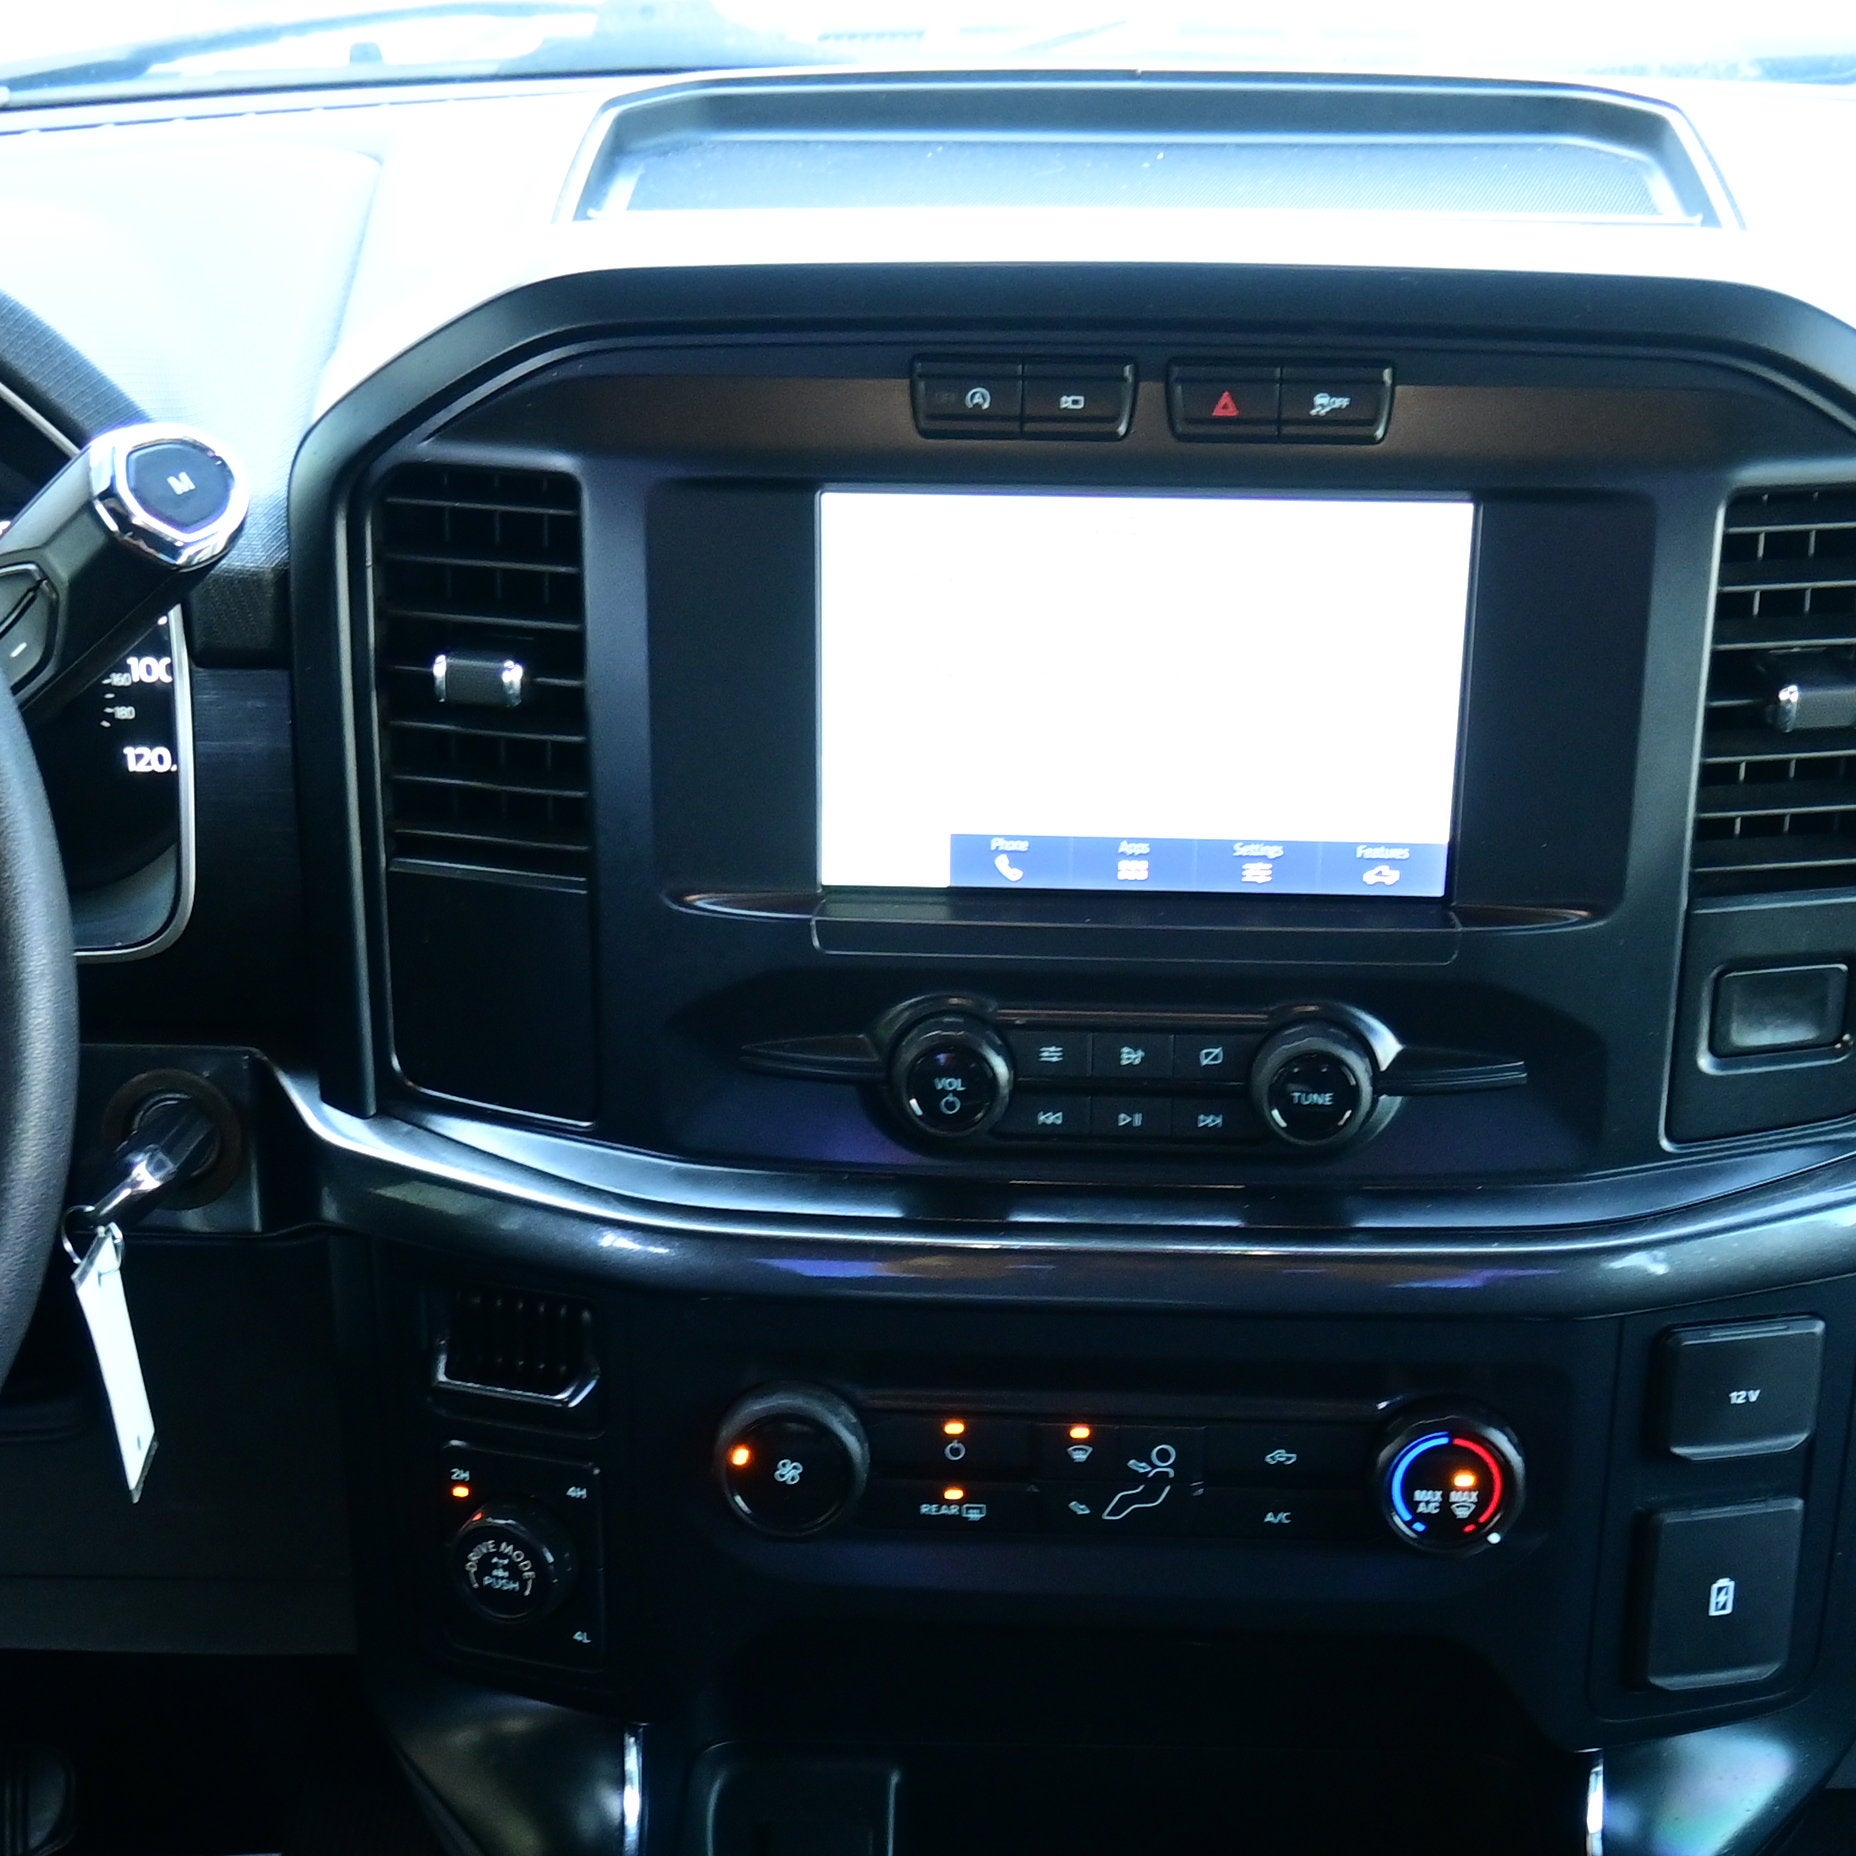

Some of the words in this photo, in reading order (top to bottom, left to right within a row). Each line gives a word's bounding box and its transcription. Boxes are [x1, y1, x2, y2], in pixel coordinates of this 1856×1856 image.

[167, 472, 196, 495] M
[123, 746, 172, 773] 120
[991, 837, 1029, 852] Phone
[1118, 840, 1151, 855] Apps
[1233, 842, 1284, 859] Settings
[1355, 844, 1409, 860] Features
[933, 1076, 966, 1091] VOL
[1291, 1091, 1334, 1106] TUNE
[1728, 1389, 1761, 1405] 12V
[450, 1468, 470, 1482] 2H
[566, 1486, 587, 1499] 4H
[1413, 1489, 1443, 1502] MAX
[1449, 1490, 1479, 1503] MAX
[919, 1503, 960, 1518] REAR
[1416, 1502, 1441, 1514] A/C
[1263, 1510, 1293, 1525] A/C
[465, 1540, 497, 1571] DRIVE
[499, 1541, 536, 1579] MODE
[482, 1576, 520, 1592] PUSH
